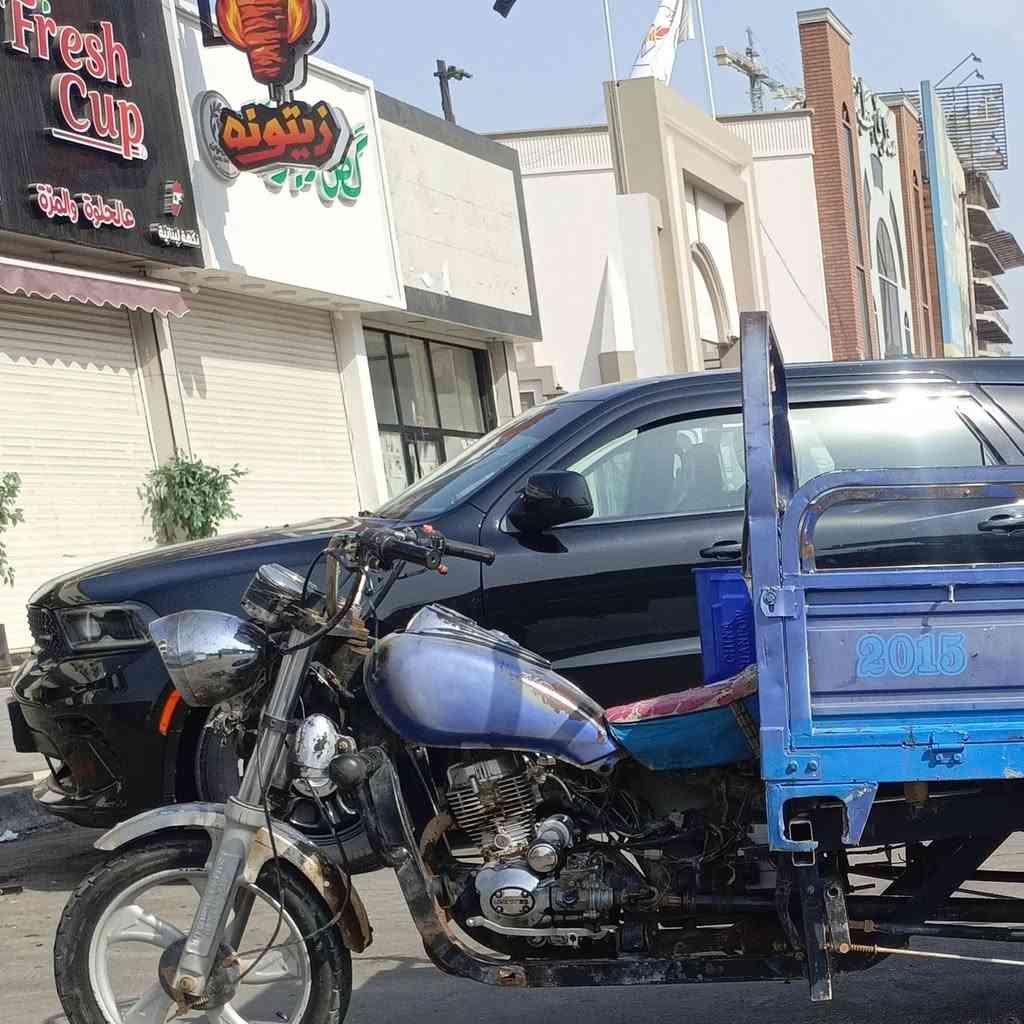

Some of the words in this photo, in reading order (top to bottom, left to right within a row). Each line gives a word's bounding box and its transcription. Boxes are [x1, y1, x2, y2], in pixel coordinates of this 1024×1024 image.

[11, 0, 132, 87] Fresh
[58, 72, 145, 160] Cup
[857, 632, 968, 678] 2015
